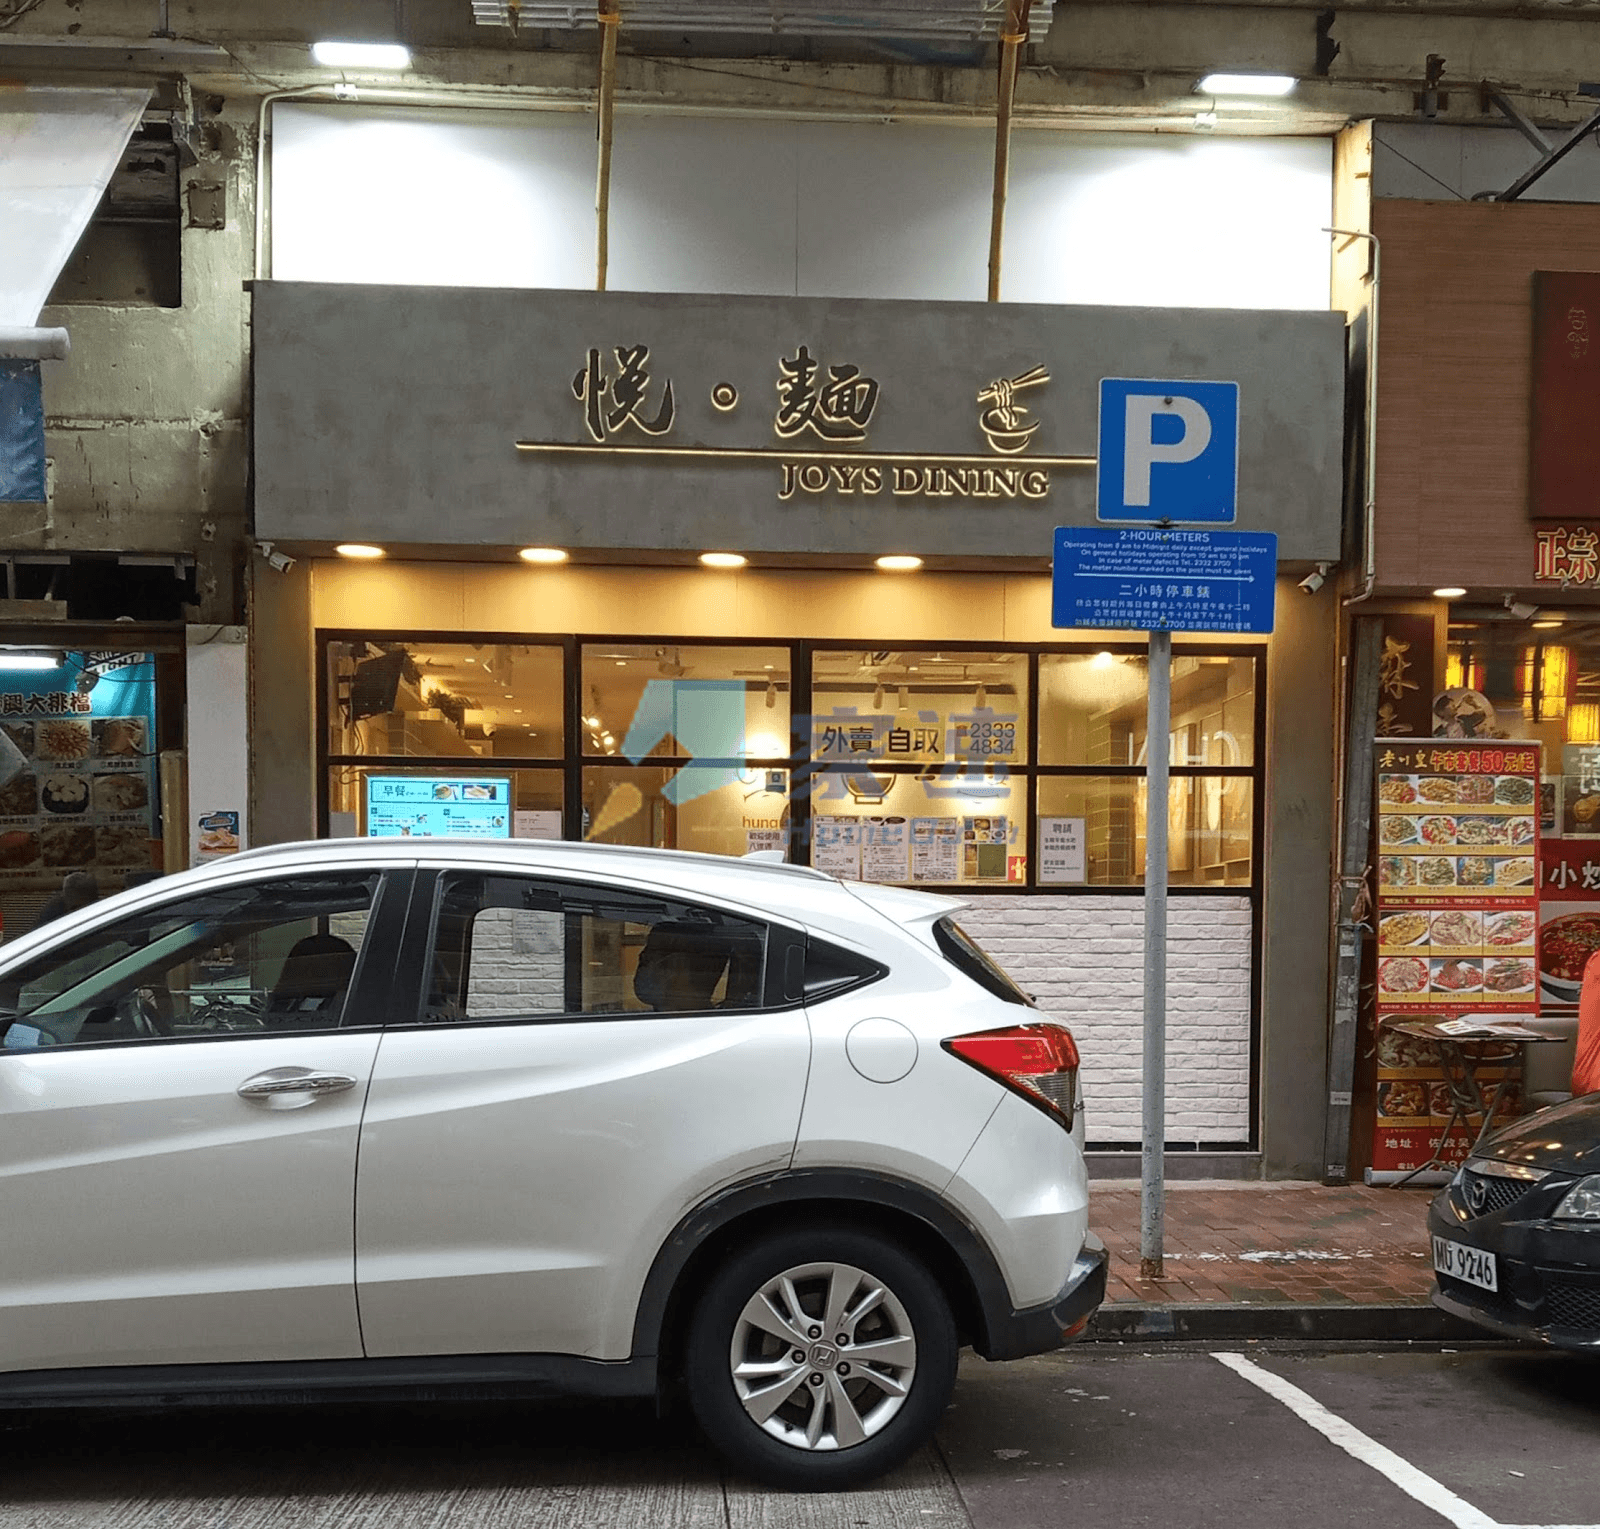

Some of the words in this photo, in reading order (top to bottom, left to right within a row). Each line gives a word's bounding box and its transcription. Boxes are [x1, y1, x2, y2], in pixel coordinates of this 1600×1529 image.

[1122, 394, 1212, 506] P
[780, 464, 883, 500] JOYS
[892, 467, 1050, 499] DINING
[1063, 541, 1096, 549] Operating
[1142, 543, 1170, 551] Midnight
[1239, 546, 1267, 554] holidays
[1120, 531, 1162, 541] 2-HOUR
[1166, 532, 1210, 543] METERS
[1092, 549, 1117, 557] general
[1118, 550, 1146, 558] holidays
[1148, 551, 1180, 559] operating
[822, 726, 875, 753] 外賣
[888, 726, 940, 754] 自取
[970, 722, 1016, 739] 2333
[970, 739, 1016, 754] 4834
[1540, 860, 1600, 889] 小炒
[1457, 1247, 1493, 1286] 9246
